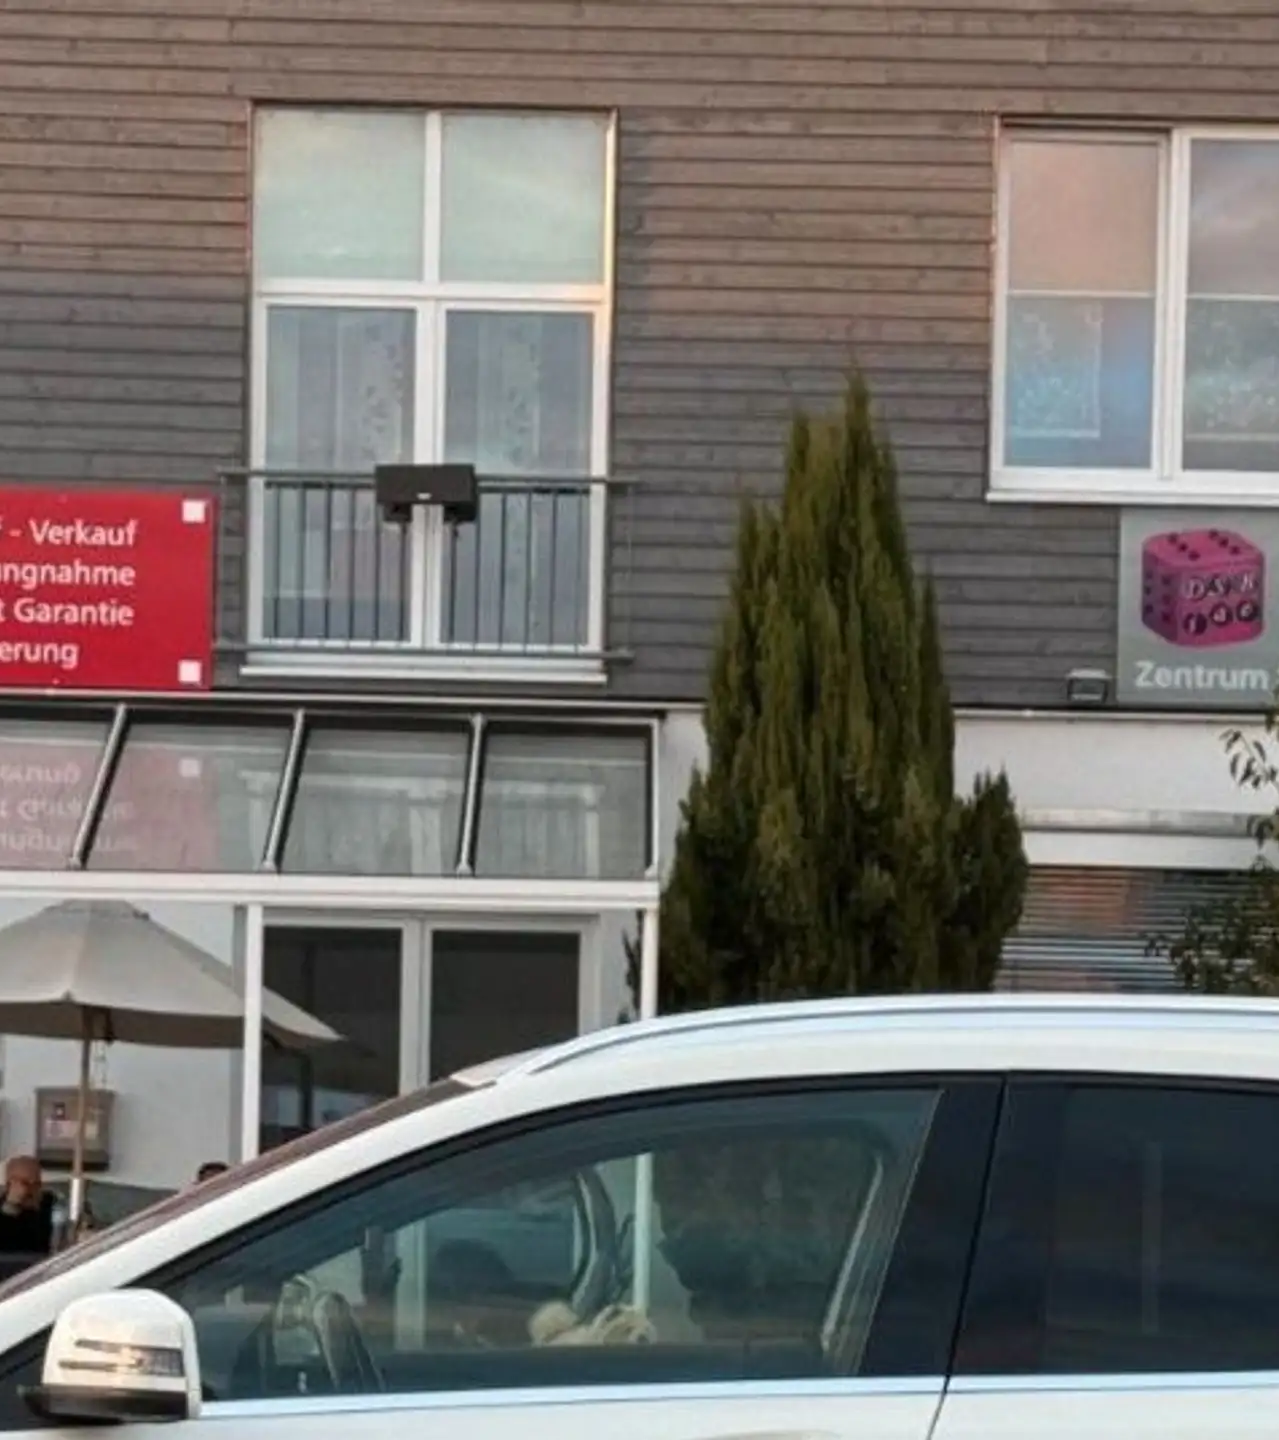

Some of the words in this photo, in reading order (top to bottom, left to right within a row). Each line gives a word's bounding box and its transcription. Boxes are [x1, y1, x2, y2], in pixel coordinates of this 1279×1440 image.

[27, 517, 137, 546] Verkauf
[13, 597, 135, 627] Garantie
[1135, 660, 1269, 690] Zentrum
